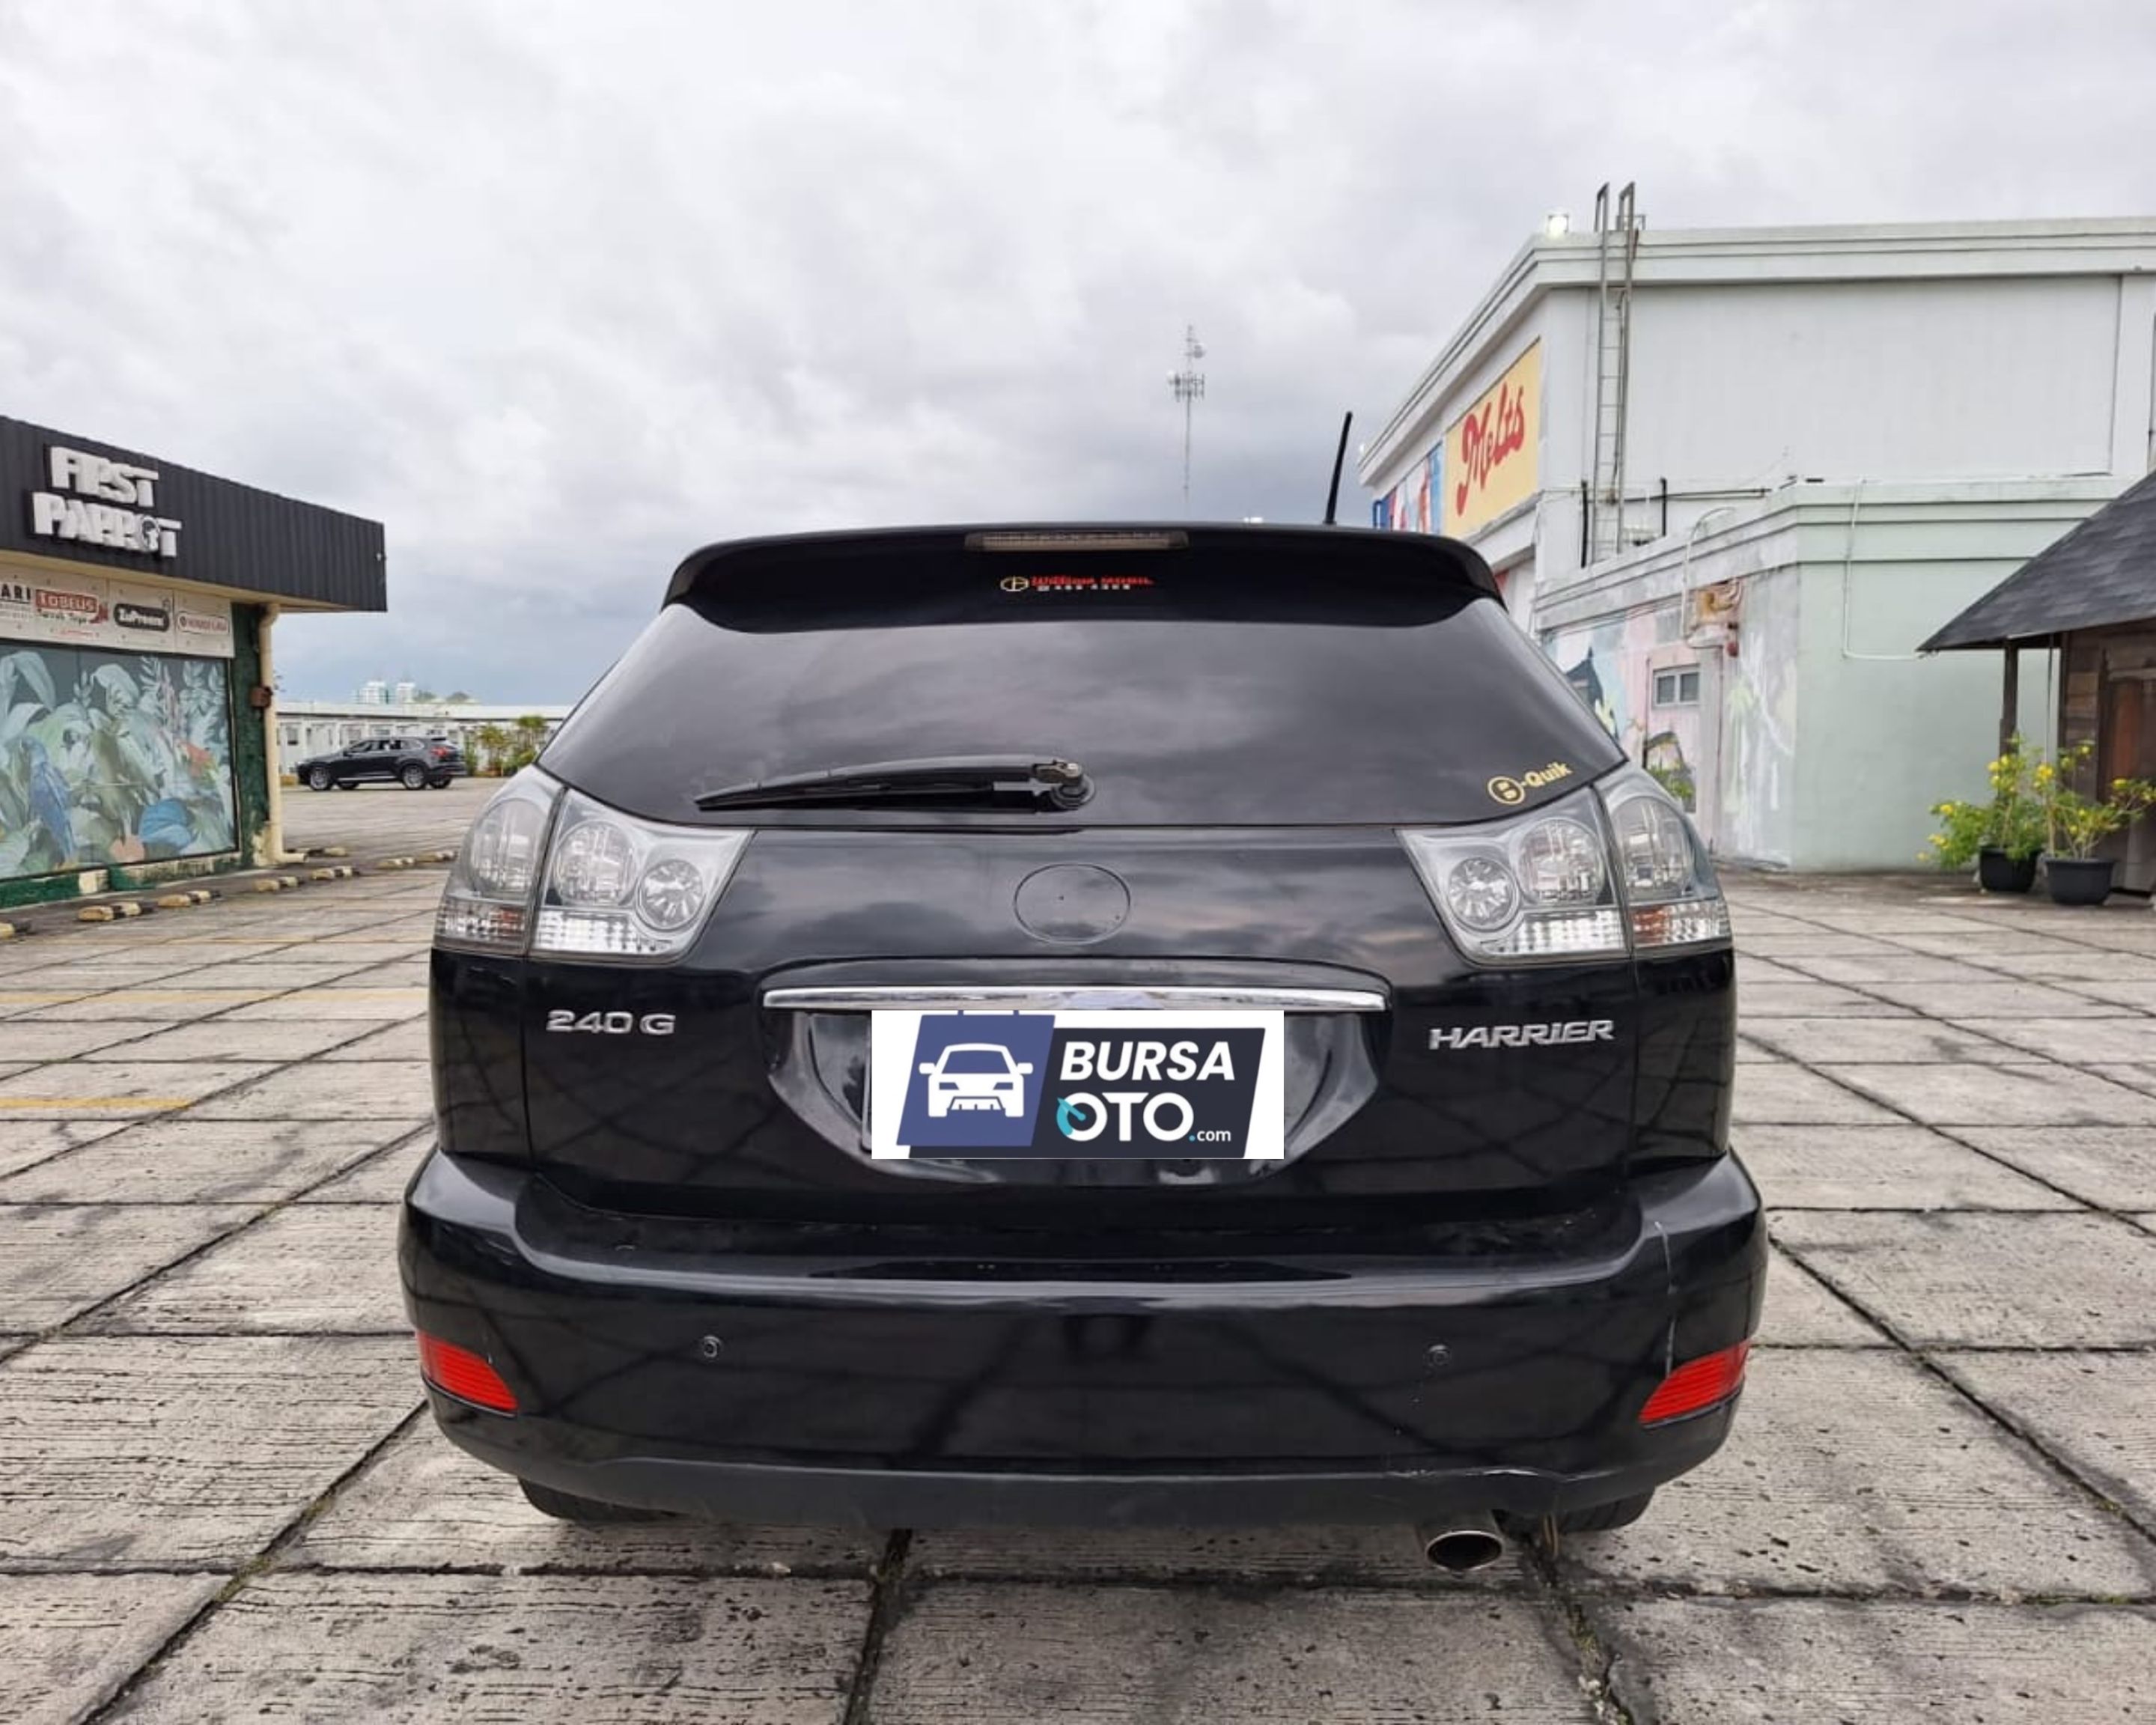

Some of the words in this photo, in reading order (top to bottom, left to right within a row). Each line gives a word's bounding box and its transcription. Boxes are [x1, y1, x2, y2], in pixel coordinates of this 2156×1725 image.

[49, 446, 159, 507] FIRST
[32, 492, 182, 558] PARROT
[546, 1009, 633, 1034] 240
[639, 1013, 677, 1035] G
[1429, 1020, 1615, 1050] HARRIER
